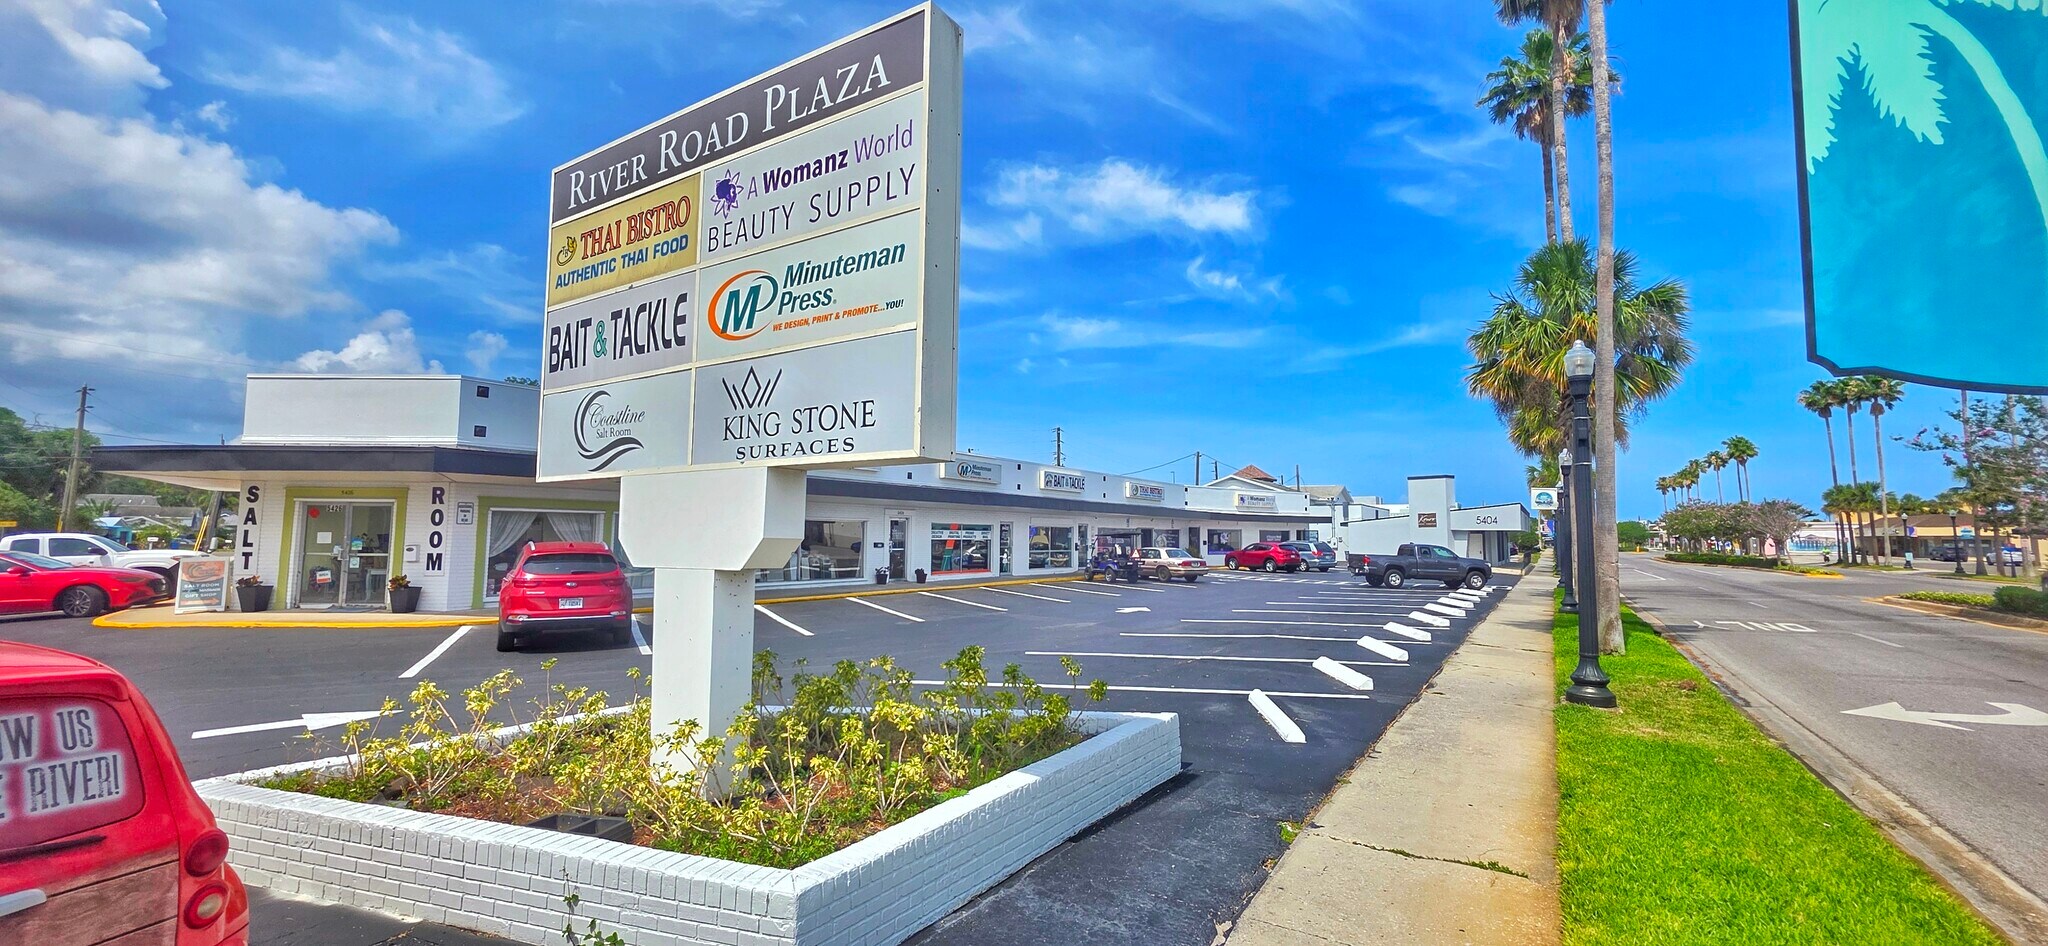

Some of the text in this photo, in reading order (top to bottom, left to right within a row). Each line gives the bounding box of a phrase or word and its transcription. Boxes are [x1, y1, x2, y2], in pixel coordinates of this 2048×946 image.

[567, 53, 892, 210] RIVER ROAD PLAZA
[747, 119, 914, 200] A Womanz World
[580, 195, 691, 260] THAI BISTRO
[708, 163, 916, 253] BEAUTY SUPPLY
[555, 234, 689, 290] AUTHENTIC THAI FOOD
[783, 243, 906, 290] Minuteman
[549, 292, 688, 373] BAIT & TACKLE
[772, 323, 783, 332] WE
[784, 317, 811, 330] DESIGN,
[811, 313, 833, 325] PRINT
[834, 311, 841, 320] &
[589, 403, 646, 428] Coastline
[596, 427, 632, 439] Salt Room
[723, 399, 877, 441] KING STONE
[736, 437, 855, 460] SURFACES
[1053, 474, 1066, 488] BAIT
[1069, 476, 1085, 490] TACKLE
[1139, 485, 1149, 493] THAI
[242, 485, 260, 570] SALT
[326, 504, 343, 512] 5426
[425, 486, 446, 571] ROOM
[1475, 515, 1498, 525] 5404
[56, 709, 94, 751] US
[27, 754, 120, 812] RIVER!
